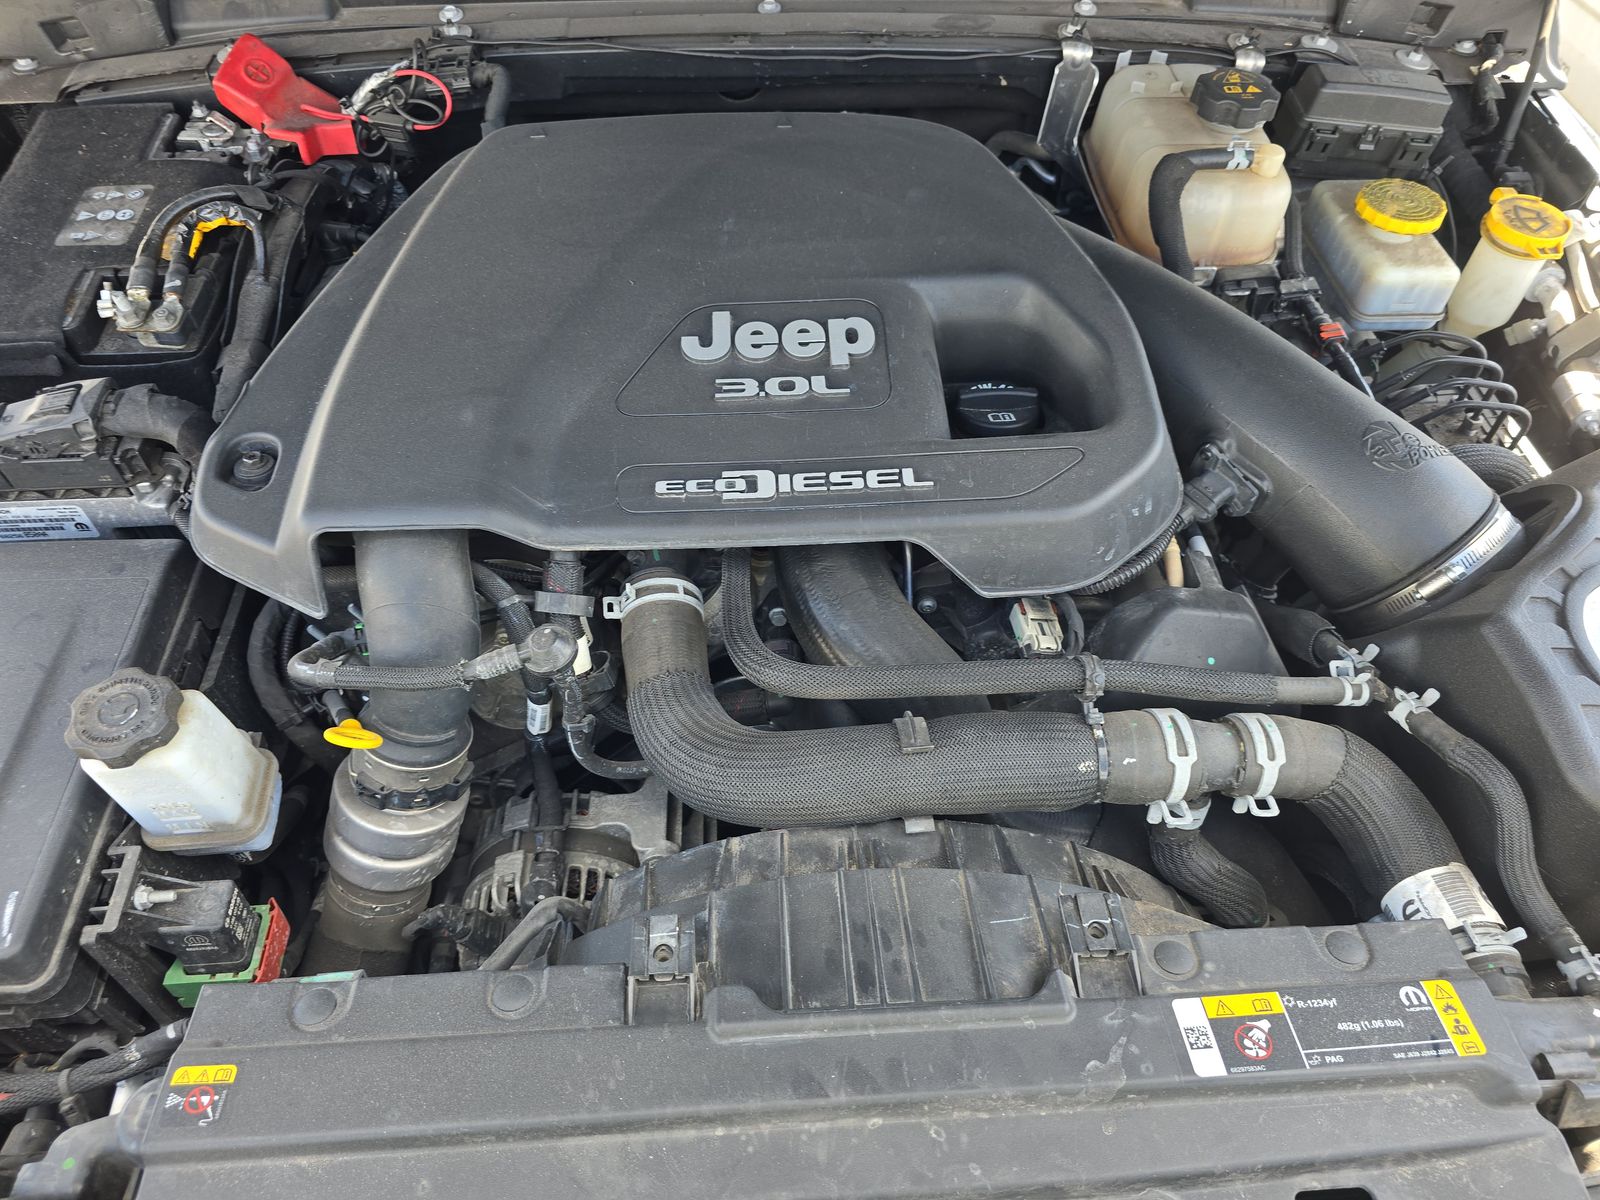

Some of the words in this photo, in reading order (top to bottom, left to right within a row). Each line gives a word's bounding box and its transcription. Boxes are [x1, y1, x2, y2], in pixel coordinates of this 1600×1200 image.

[681, 311, 876, 368] Jeep
[714, 375, 851, 399] 3.0L
[1296, 998, 1338, 1009] R-1234yf
[1337, 1020, 1362, 1032] 482g
[1362, 1019, 1382, 1031] (1.06
[1385, 1018, 1405, 1029] lbs)
[1325, 1055, 1345, 1064] PAG
